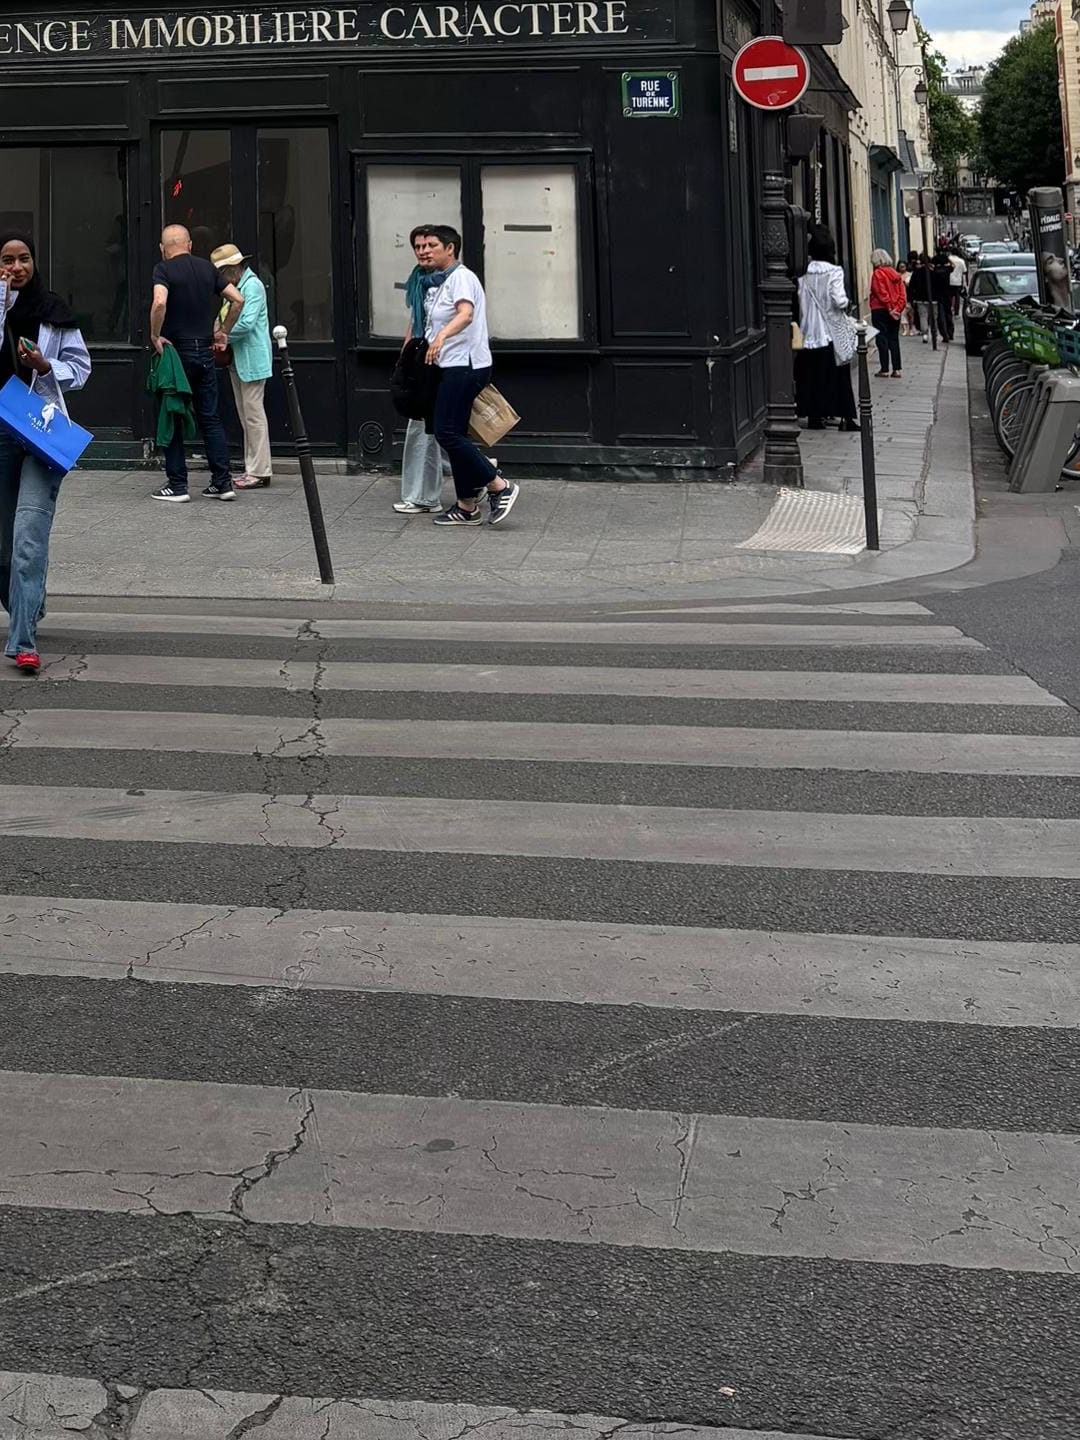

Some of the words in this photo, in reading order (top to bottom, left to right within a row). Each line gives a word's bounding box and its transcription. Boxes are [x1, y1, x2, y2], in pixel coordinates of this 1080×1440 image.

[108, 8, 361, 50] IMMOBILIERE
[379, 0, 630, 40] CARACTERE
[640, 80, 661, 91] RUE
[631, 96, 670, 108] TURENNE
